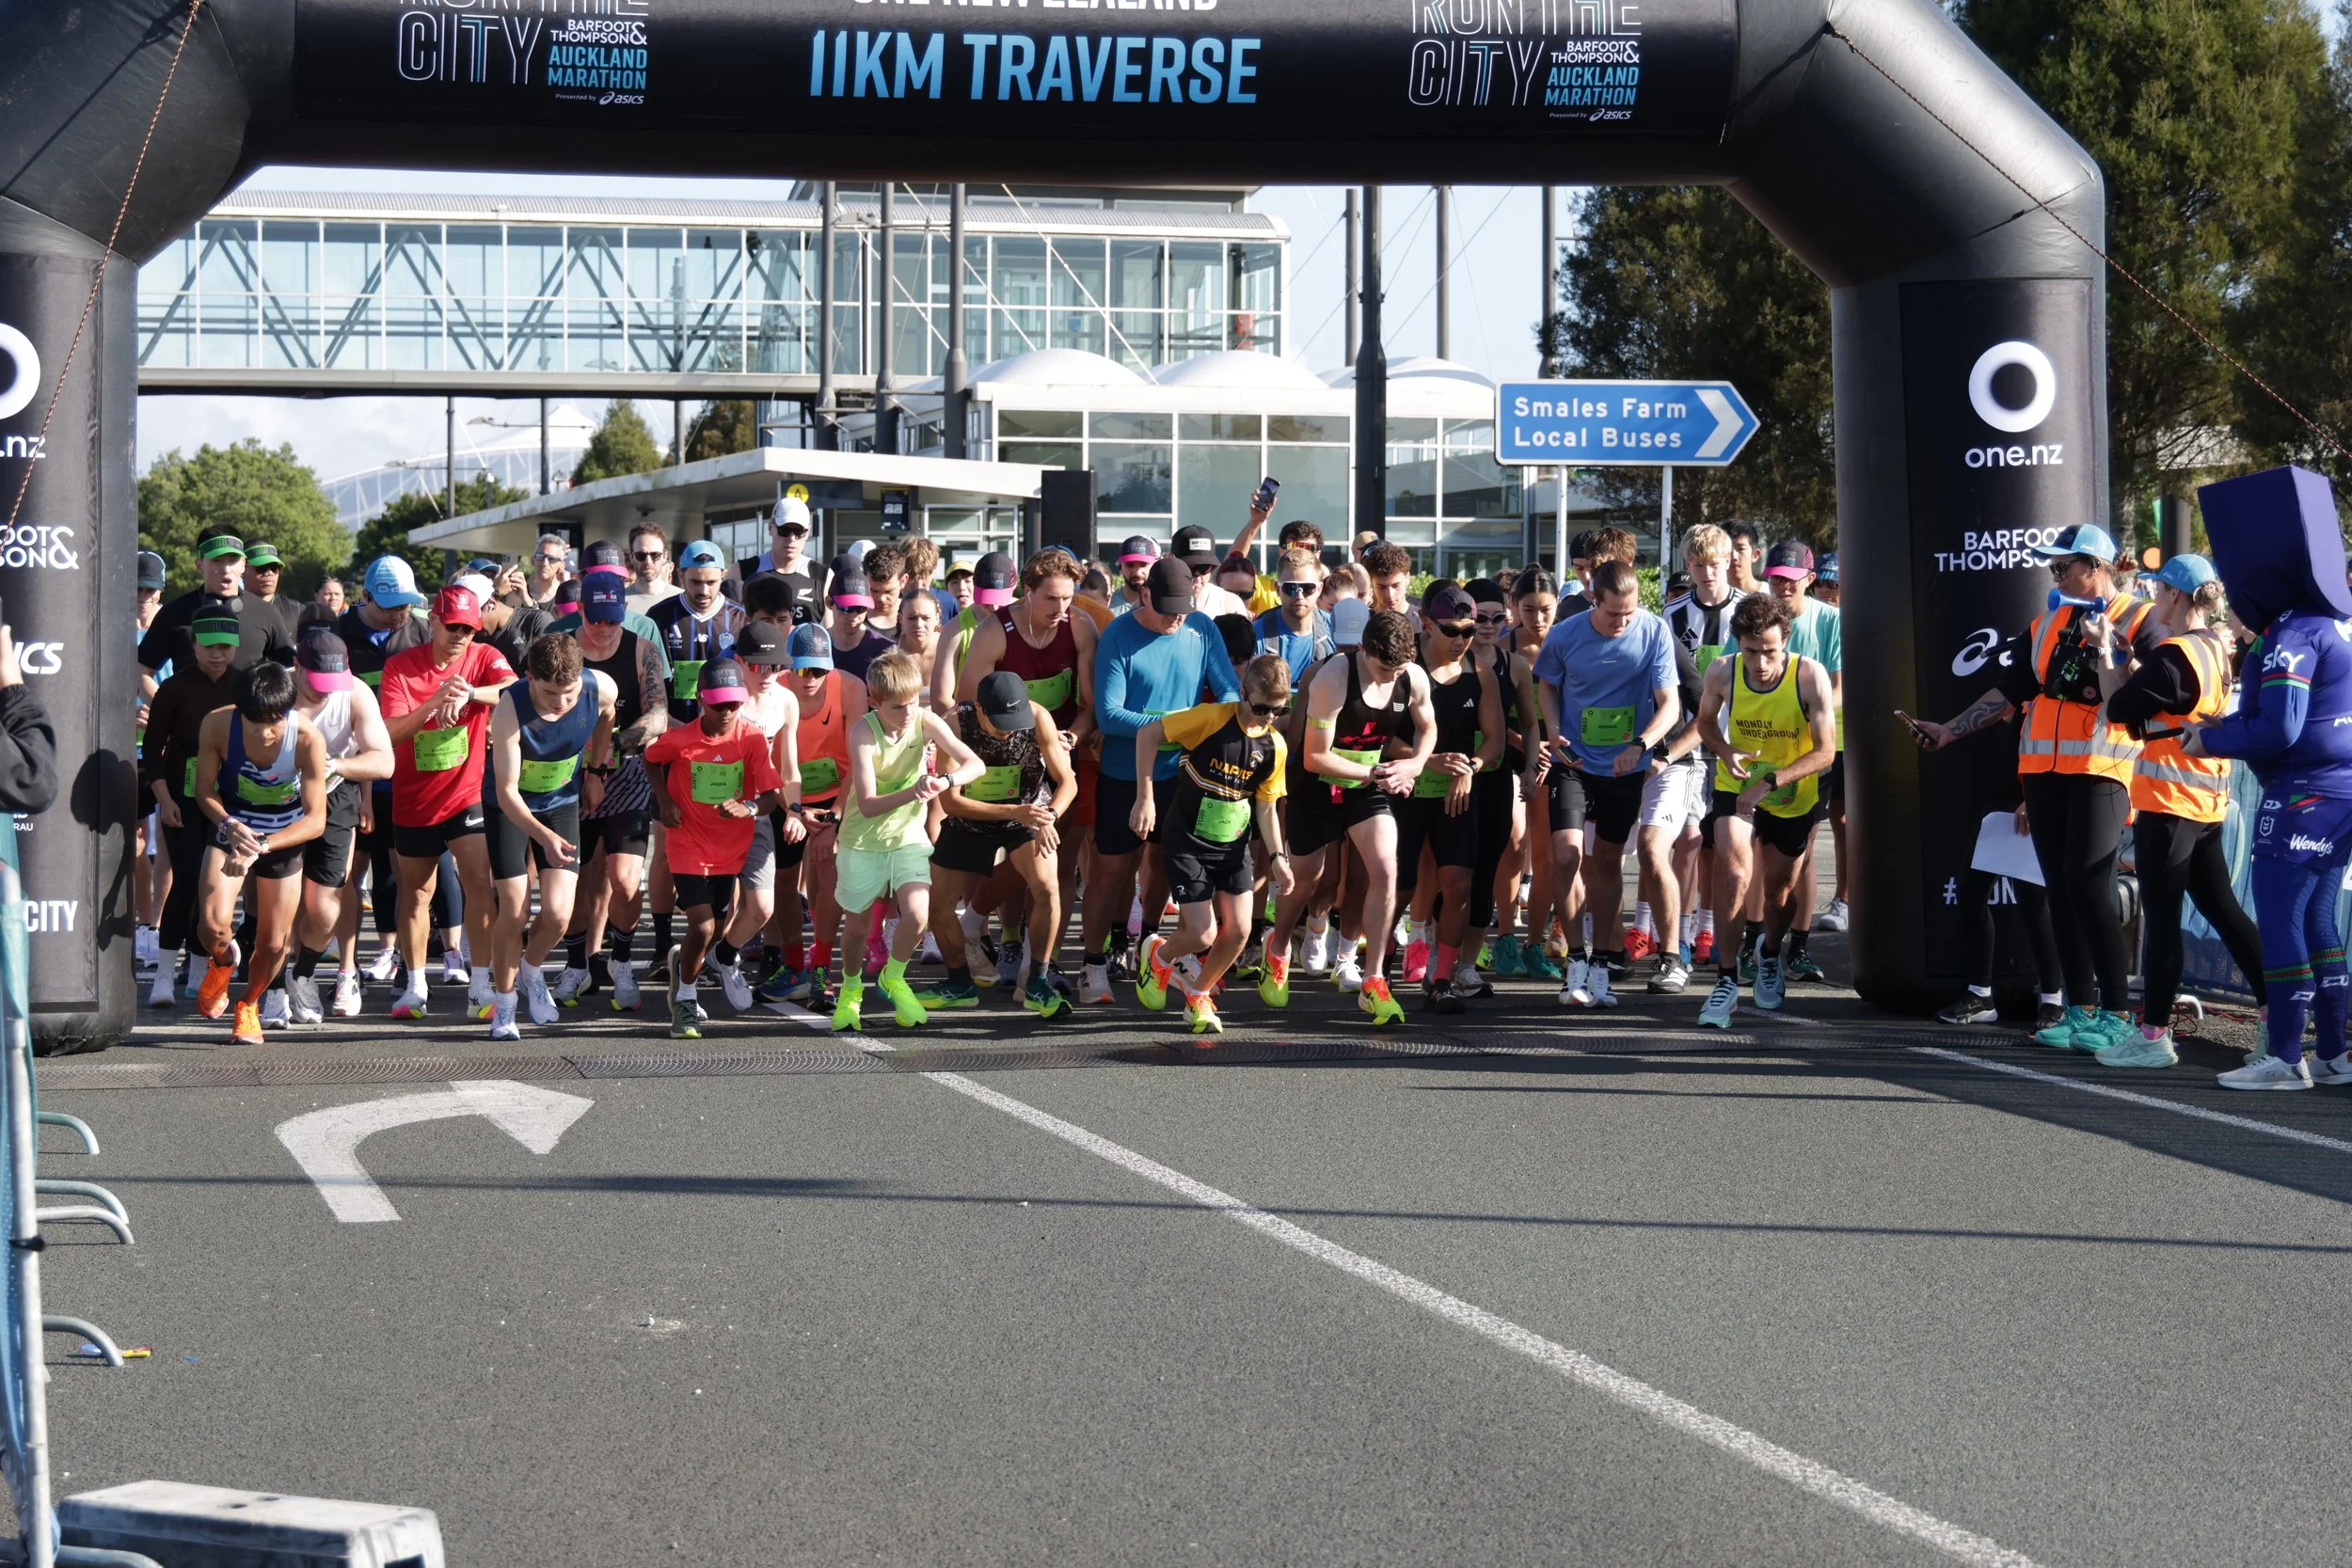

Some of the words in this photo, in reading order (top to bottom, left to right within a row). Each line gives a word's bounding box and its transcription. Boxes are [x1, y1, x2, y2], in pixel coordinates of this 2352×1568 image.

[550, 30, 630, 44] THOMPSON
[567, 19, 631, 34] BARFOOT
[629, 22, 648, 45] &
[399, 11, 543, 85] CITY
[548, 46, 648, 69] AUCKLAND
[1550, 52, 1623, 63] THOMPSON
[1566, 40, 1625, 54] BARFOOT
[1623, 40, 1640, 64] &
[810, 29, 945, 100] 11KM
[962, 34, 1262, 103] TRAVERSE
[1408, 40, 1544, 106] CITY
[1548, 67, 1640, 87] AUCKLAND
[548, 69, 646, 89] MARATHON
[555, 92, 587, 102] Presented
[588, 94, 596, 103] by
[1545, 87, 1637, 106] MARATHON
[1579, 112, 1587, 120] by
[1515, 396, 1608, 419] Smales
[1622, 398, 1687, 419] Farm
[1515, 426, 1587, 448] Local
[1602, 427, 1682, 448] Buses
[1964, 443, 2063, 469] one.nz
[1736, 720, 1772, 729] MONDAY
[1740, 728, 1800, 739] UNDERGROUND
[2289, 833, 2334, 857] Wendy's
[24, 900, 78, 932] CITY
